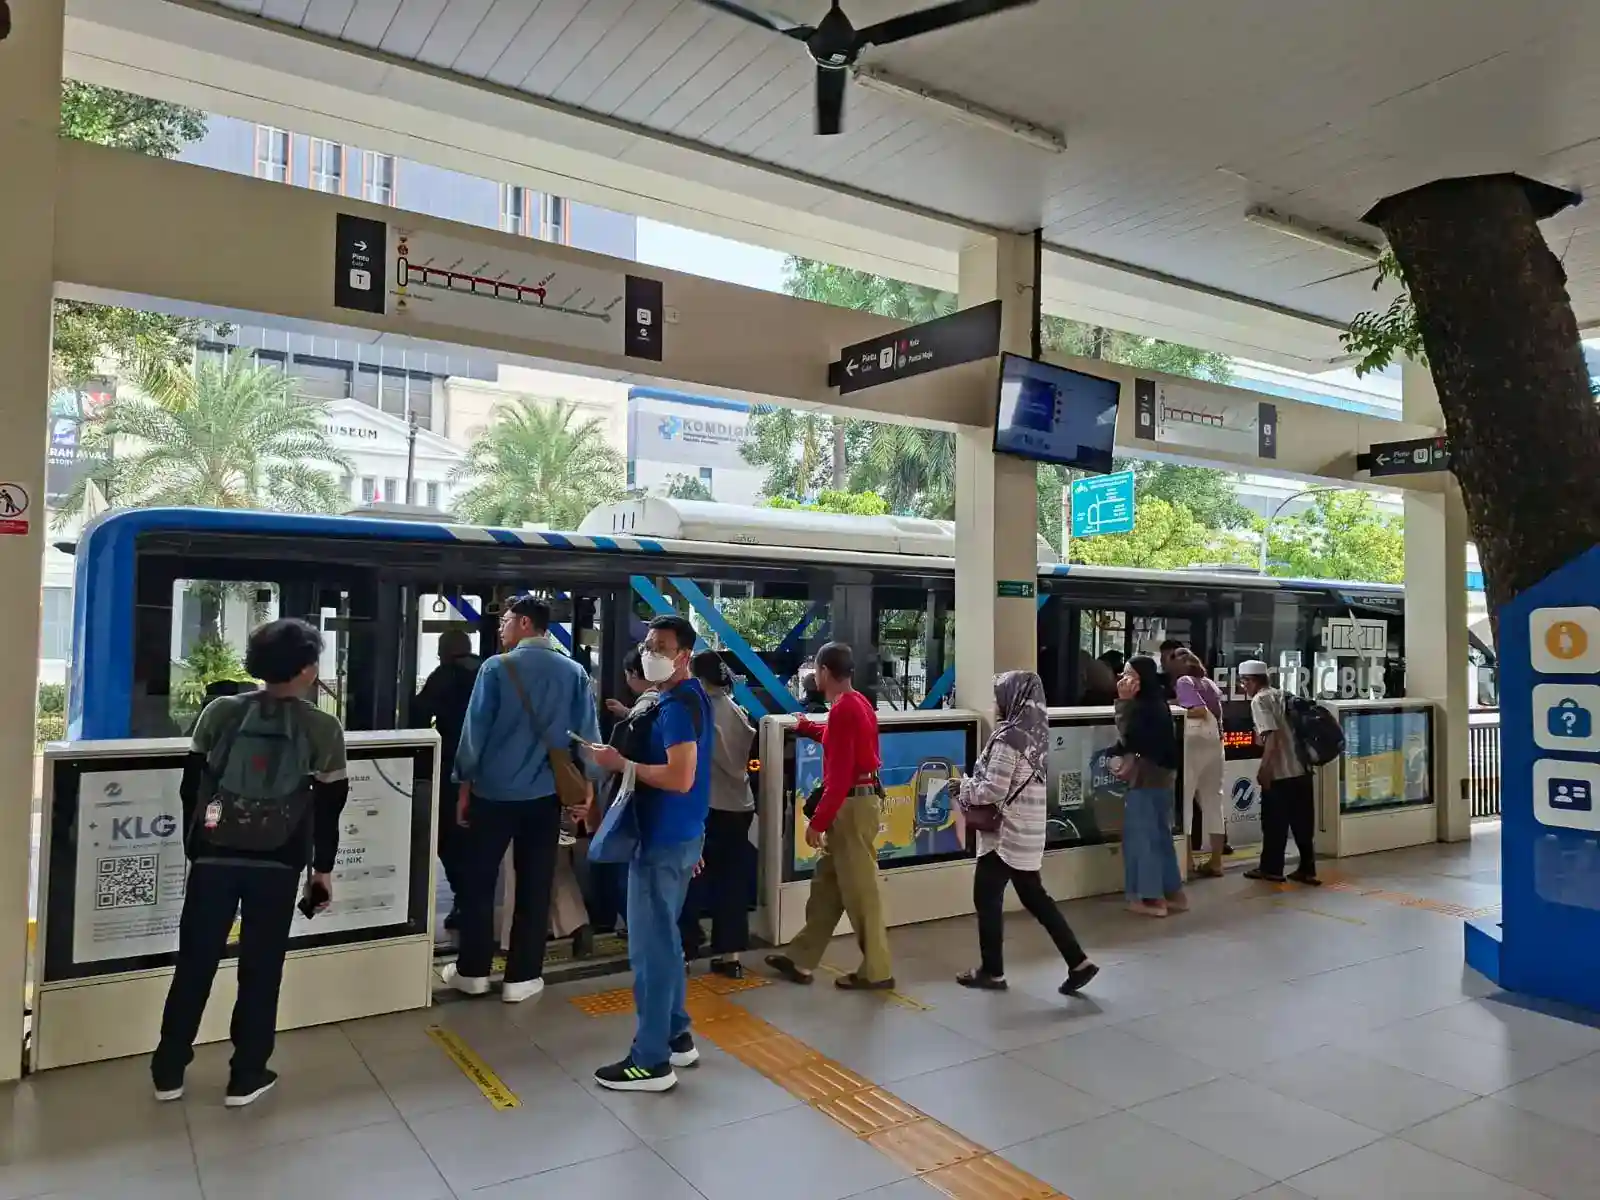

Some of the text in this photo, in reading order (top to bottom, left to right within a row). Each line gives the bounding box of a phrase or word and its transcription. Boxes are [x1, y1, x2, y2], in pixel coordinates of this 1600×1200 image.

[49, 446, 74, 459] RAH
[1213, 665, 1386, 701] ELCTRIC BUS
[112, 815, 177, 840] KLG
